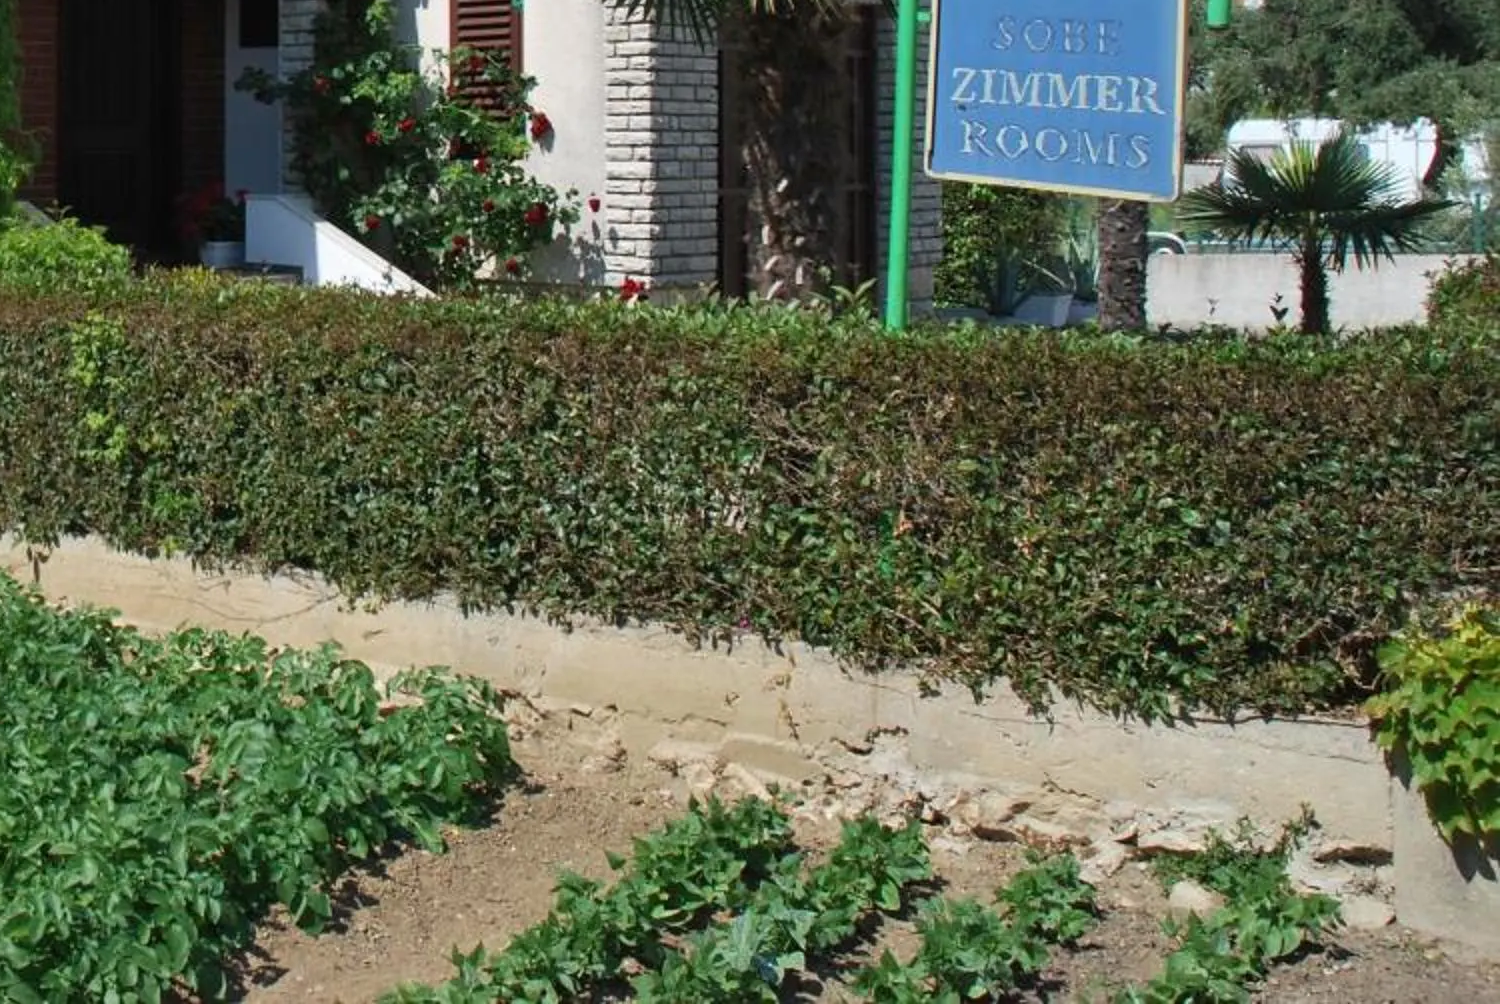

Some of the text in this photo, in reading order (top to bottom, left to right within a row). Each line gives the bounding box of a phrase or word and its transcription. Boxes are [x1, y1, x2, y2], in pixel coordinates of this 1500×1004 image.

[993, 15, 1123, 56] SOBE
[950, 67, 1167, 115] ZIMMER
[959, 119, 1150, 169] ROOMS
